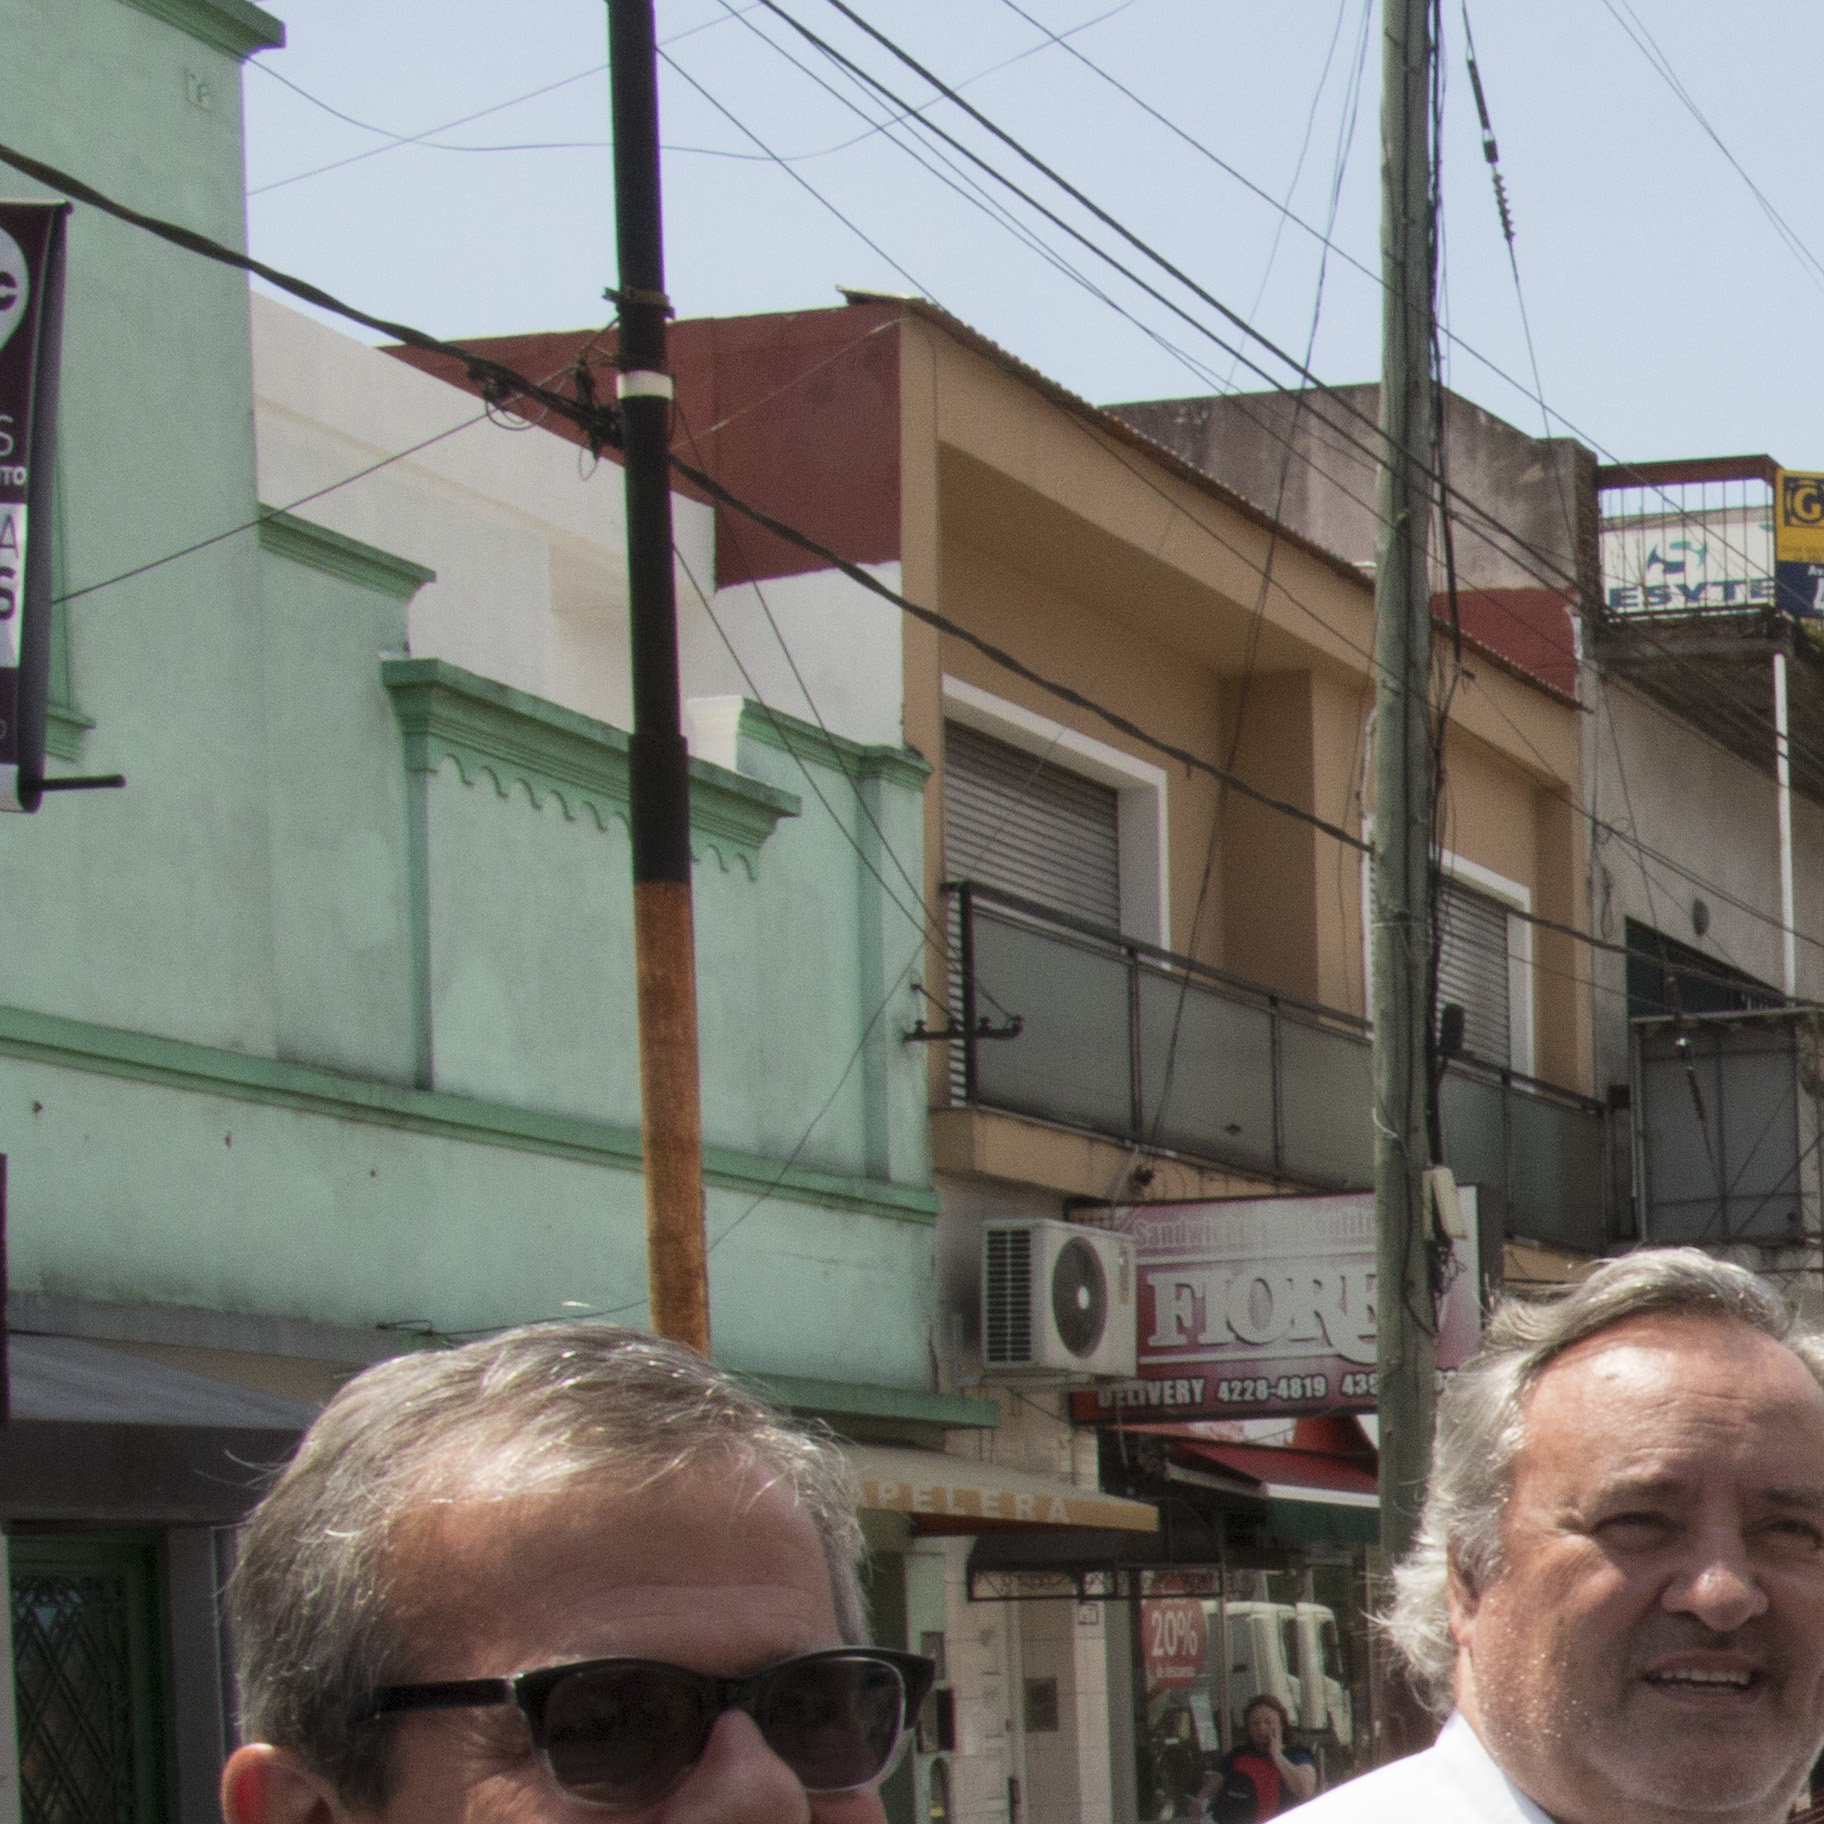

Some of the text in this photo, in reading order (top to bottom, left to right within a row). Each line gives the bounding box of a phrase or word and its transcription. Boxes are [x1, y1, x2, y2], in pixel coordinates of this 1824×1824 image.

[1097, 1377, 1206, 1408] DELIVERY
[1217, 1374, 1328, 1402] 4228-4819
[1151, 1610, 1198, 1657] 20%
